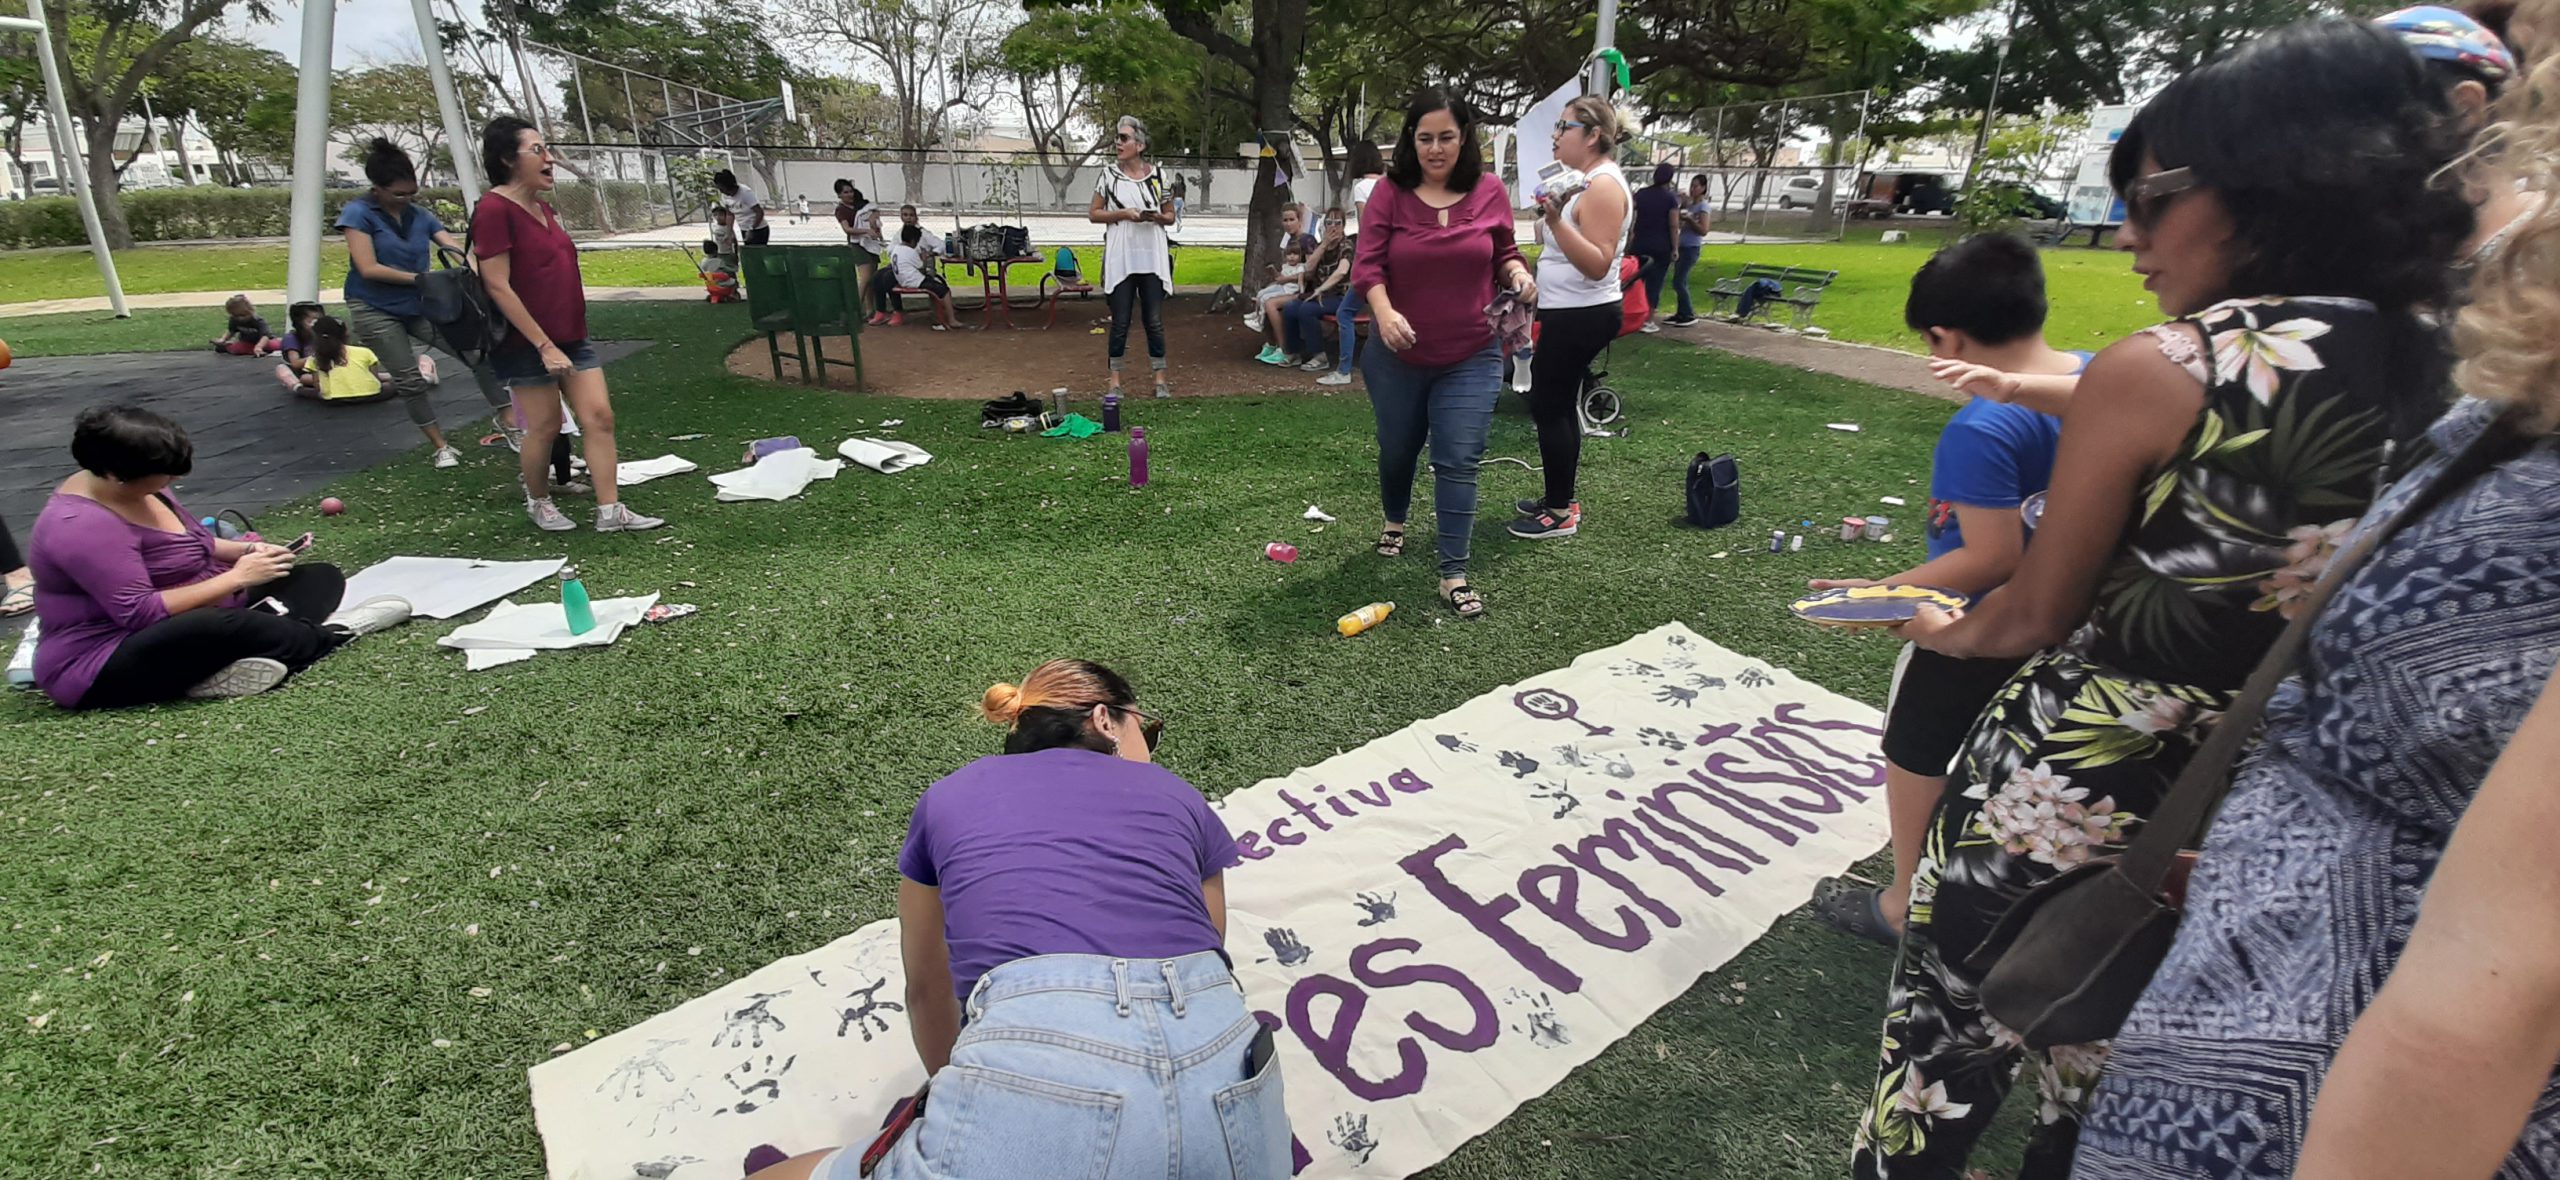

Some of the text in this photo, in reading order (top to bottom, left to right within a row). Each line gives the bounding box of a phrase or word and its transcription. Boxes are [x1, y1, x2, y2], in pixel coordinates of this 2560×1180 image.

[1223, 768, 1433, 868] ectiva
[1252, 702, 1888, 1102] es Feministas
